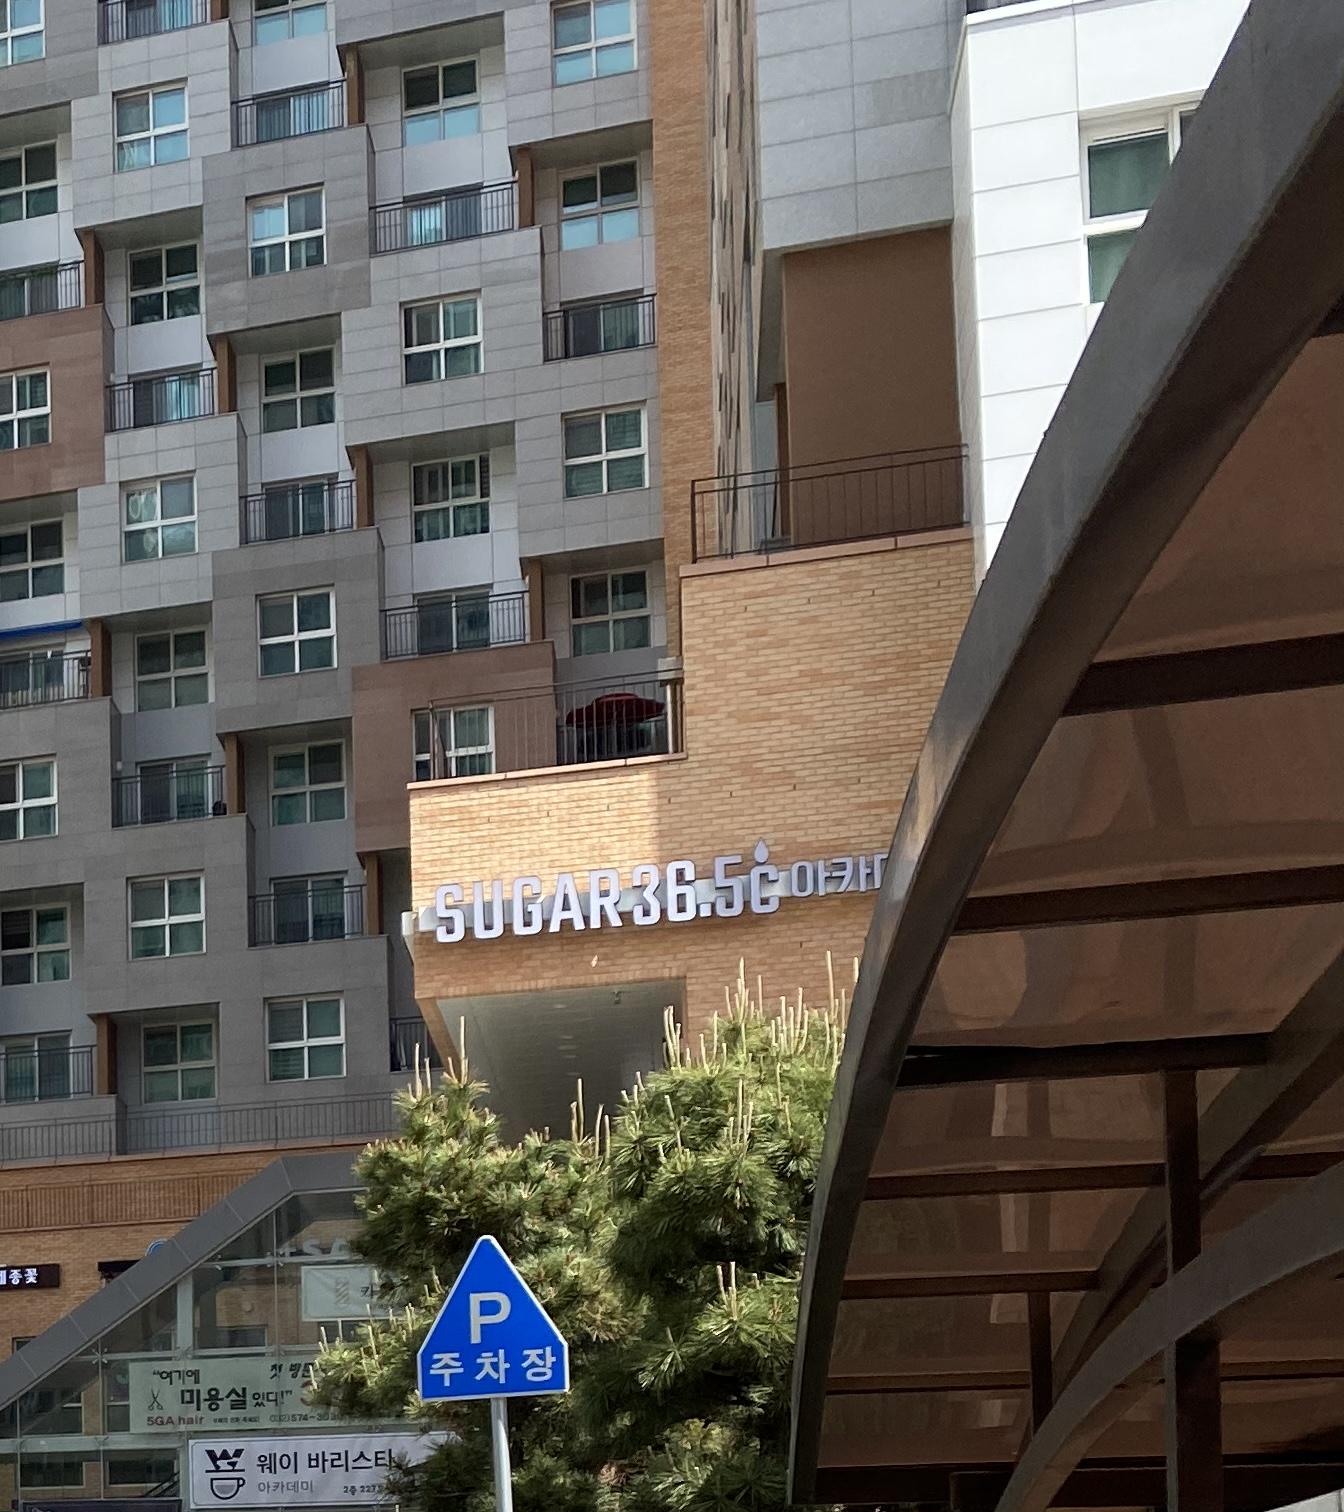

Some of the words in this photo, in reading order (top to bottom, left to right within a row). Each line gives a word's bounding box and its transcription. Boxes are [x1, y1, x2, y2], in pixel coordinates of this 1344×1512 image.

[470, 1293, 511, 1344] P
[430, 1347, 556, 1387] 주차장
[180, 1387, 247, 1411] 미용실
[178, 1415, 205, 1426] hair
[256, 1451, 298, 1474] 웨이
[307, 1449, 396, 1474] 바리스타
[258, 1480, 313, 1494] 아카데미
[343, 1485, 358, 1496] 2층
